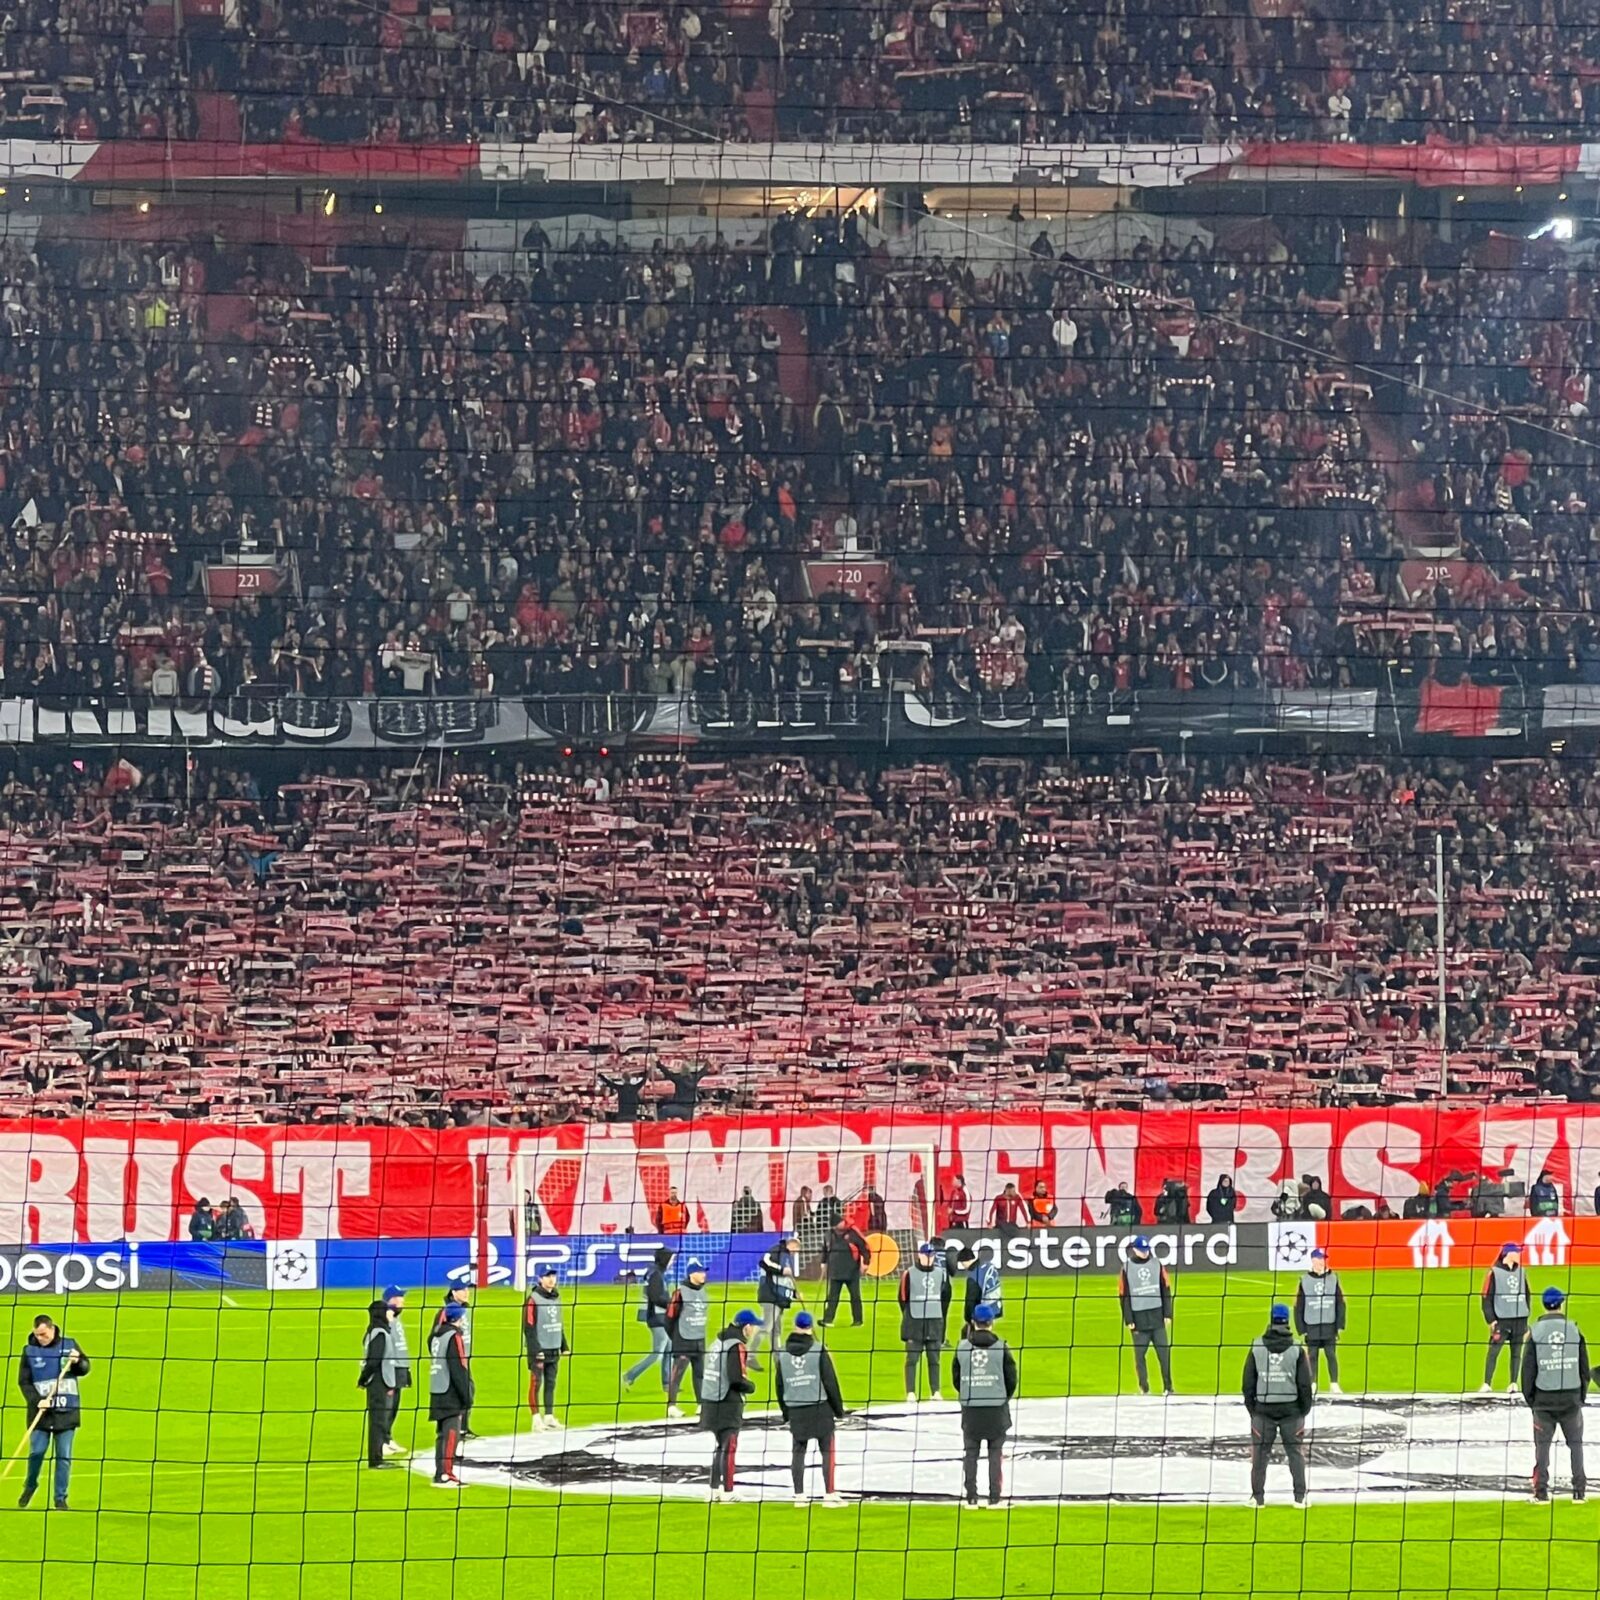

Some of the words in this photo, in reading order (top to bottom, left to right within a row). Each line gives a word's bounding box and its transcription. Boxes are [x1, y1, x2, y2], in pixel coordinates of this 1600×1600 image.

[238, 574, 260, 587] 221
[837, 569, 862, 583] 220
[0, 1132, 371, 1244] RUST
[1199, 1120, 1421, 1223] BIS
[526, 1242, 664, 1277] PS5
